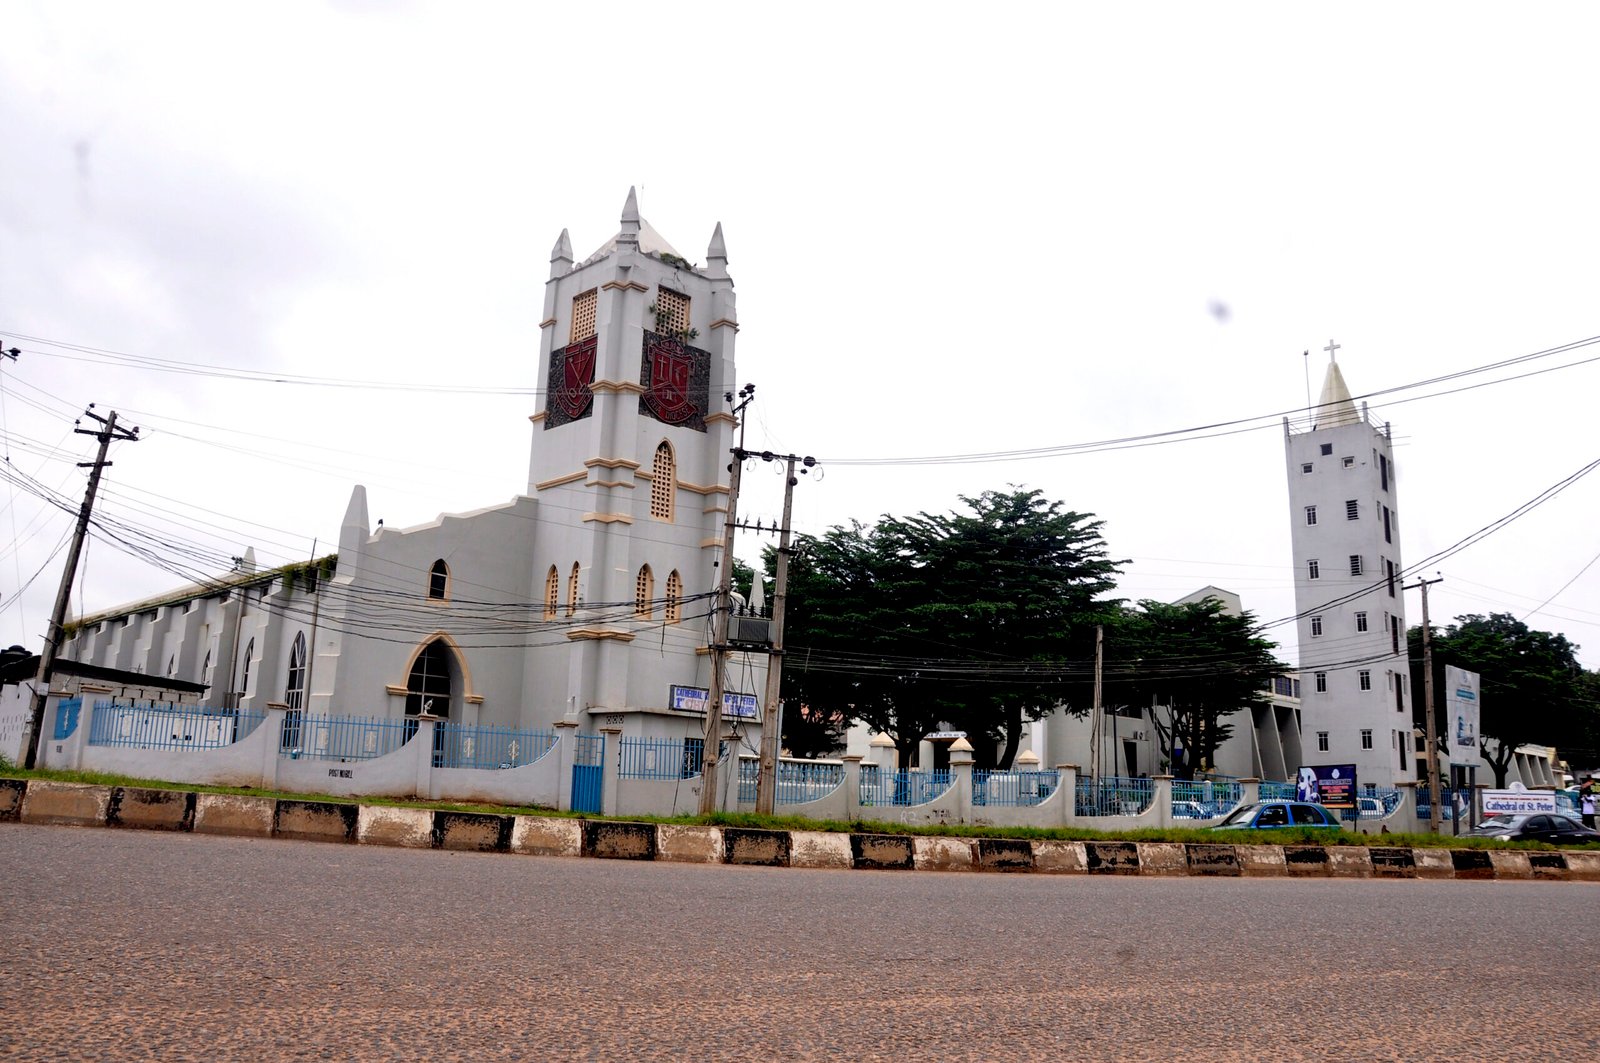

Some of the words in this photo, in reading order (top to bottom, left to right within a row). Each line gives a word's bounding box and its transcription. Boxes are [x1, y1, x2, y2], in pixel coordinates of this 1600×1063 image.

[675, 688, 703, 700] CATHEDRAL
[1485, 801, 1518, 811] Cathedral
[1518, 801, 1526, 811] of
[1527, 802, 1536, 811] St.
[1537, 802, 1554, 812] Peter
